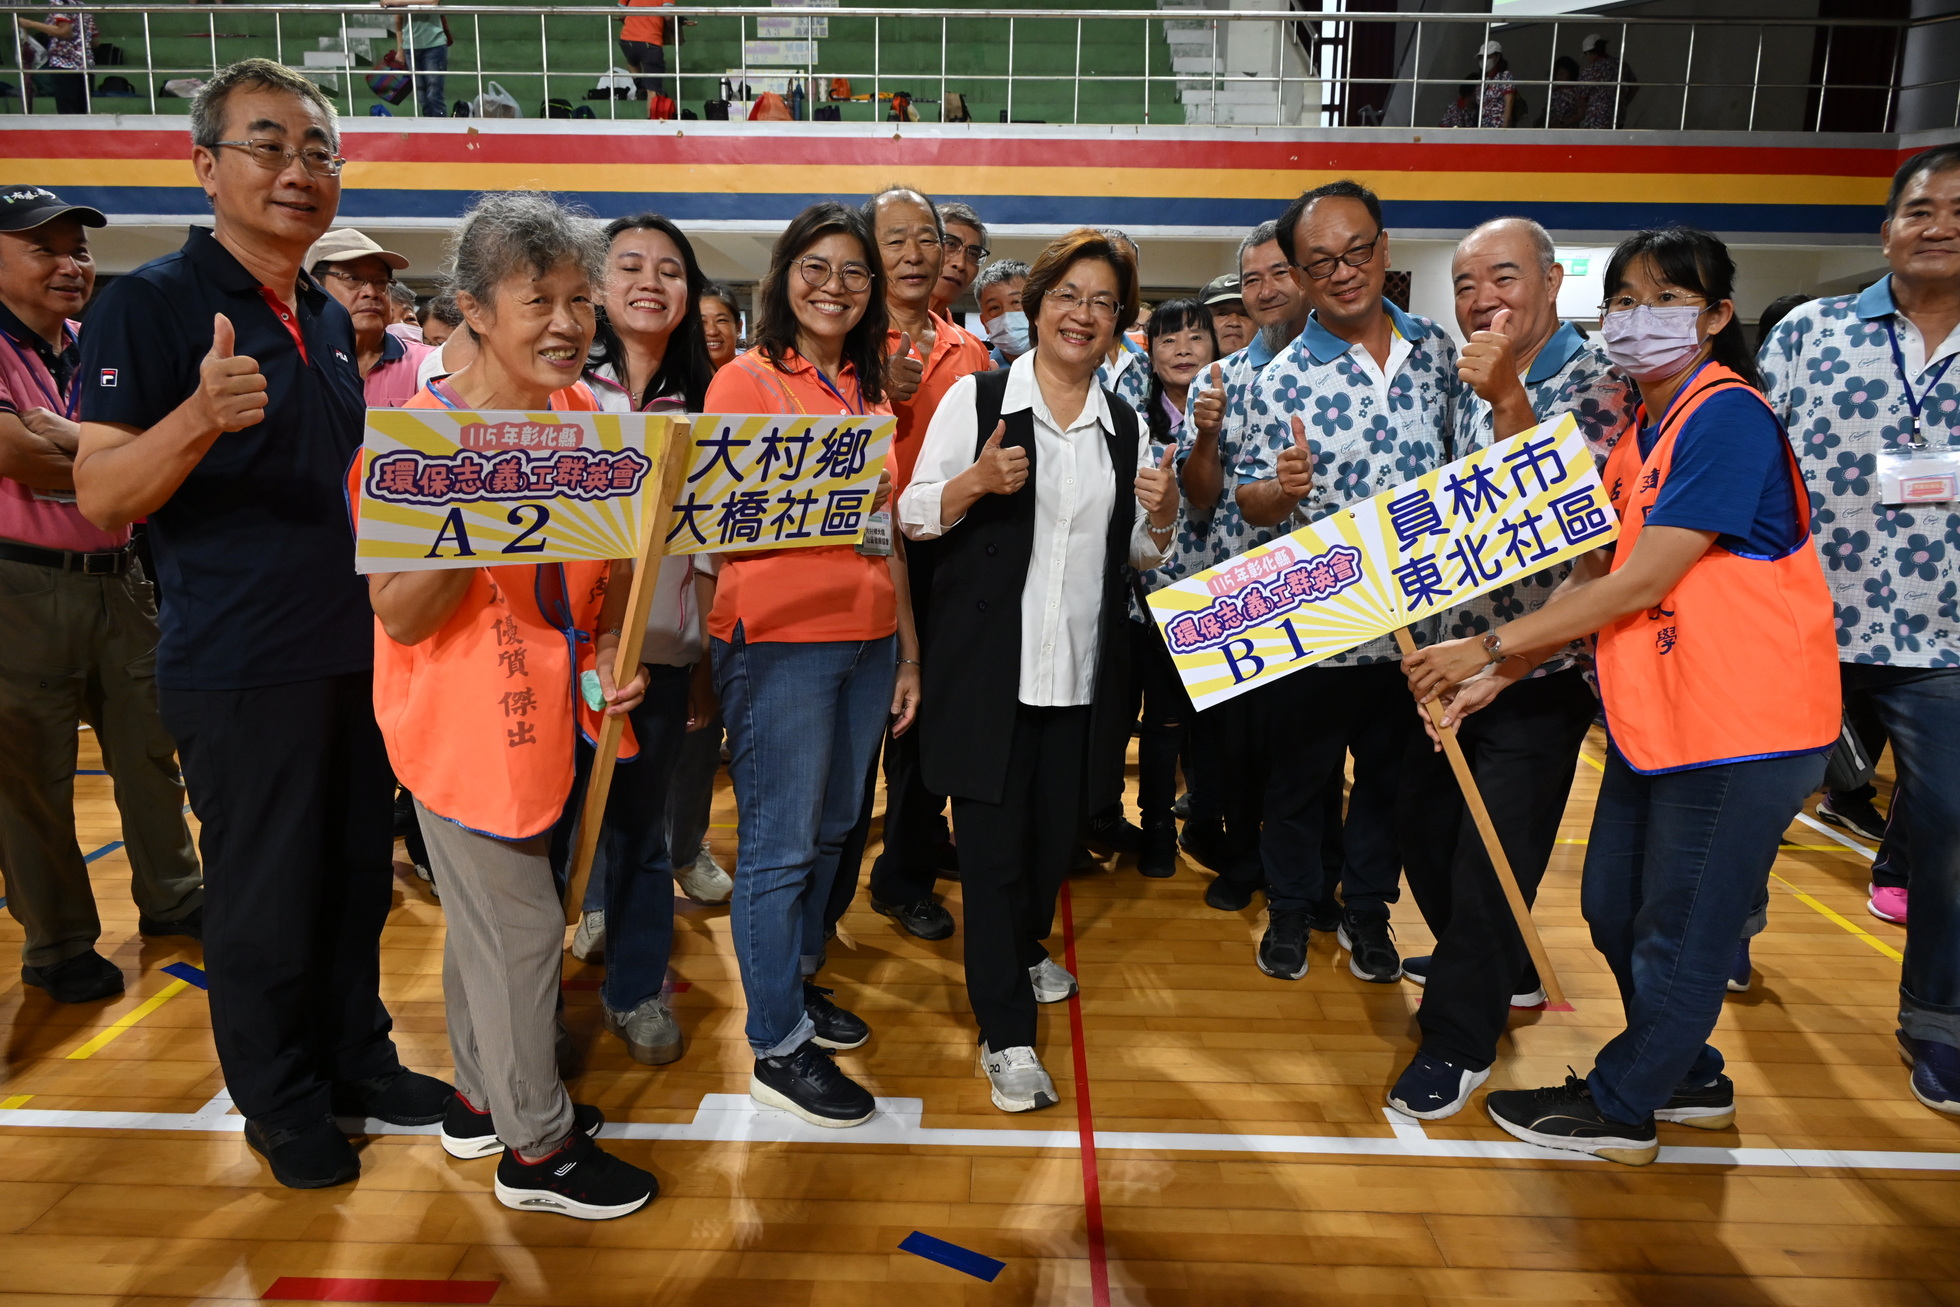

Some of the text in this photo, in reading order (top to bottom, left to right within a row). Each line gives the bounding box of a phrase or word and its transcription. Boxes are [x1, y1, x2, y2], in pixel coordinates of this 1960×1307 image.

[468, 424, 578, 448] 115年彰化縣
[687, 426, 873, 483] 大村鄉
[379, 454, 643, 496] 環保志(義)工群英會
[1387, 437, 1567, 552] 員林市
[665, 488, 871, 545] 大橋社區
[1211, 547, 1292, 594] 115年彰化縣
[1391, 484, 1613, 612] 東北社區
[1172, 551, 1356, 649] 環保志(義)工群英會
